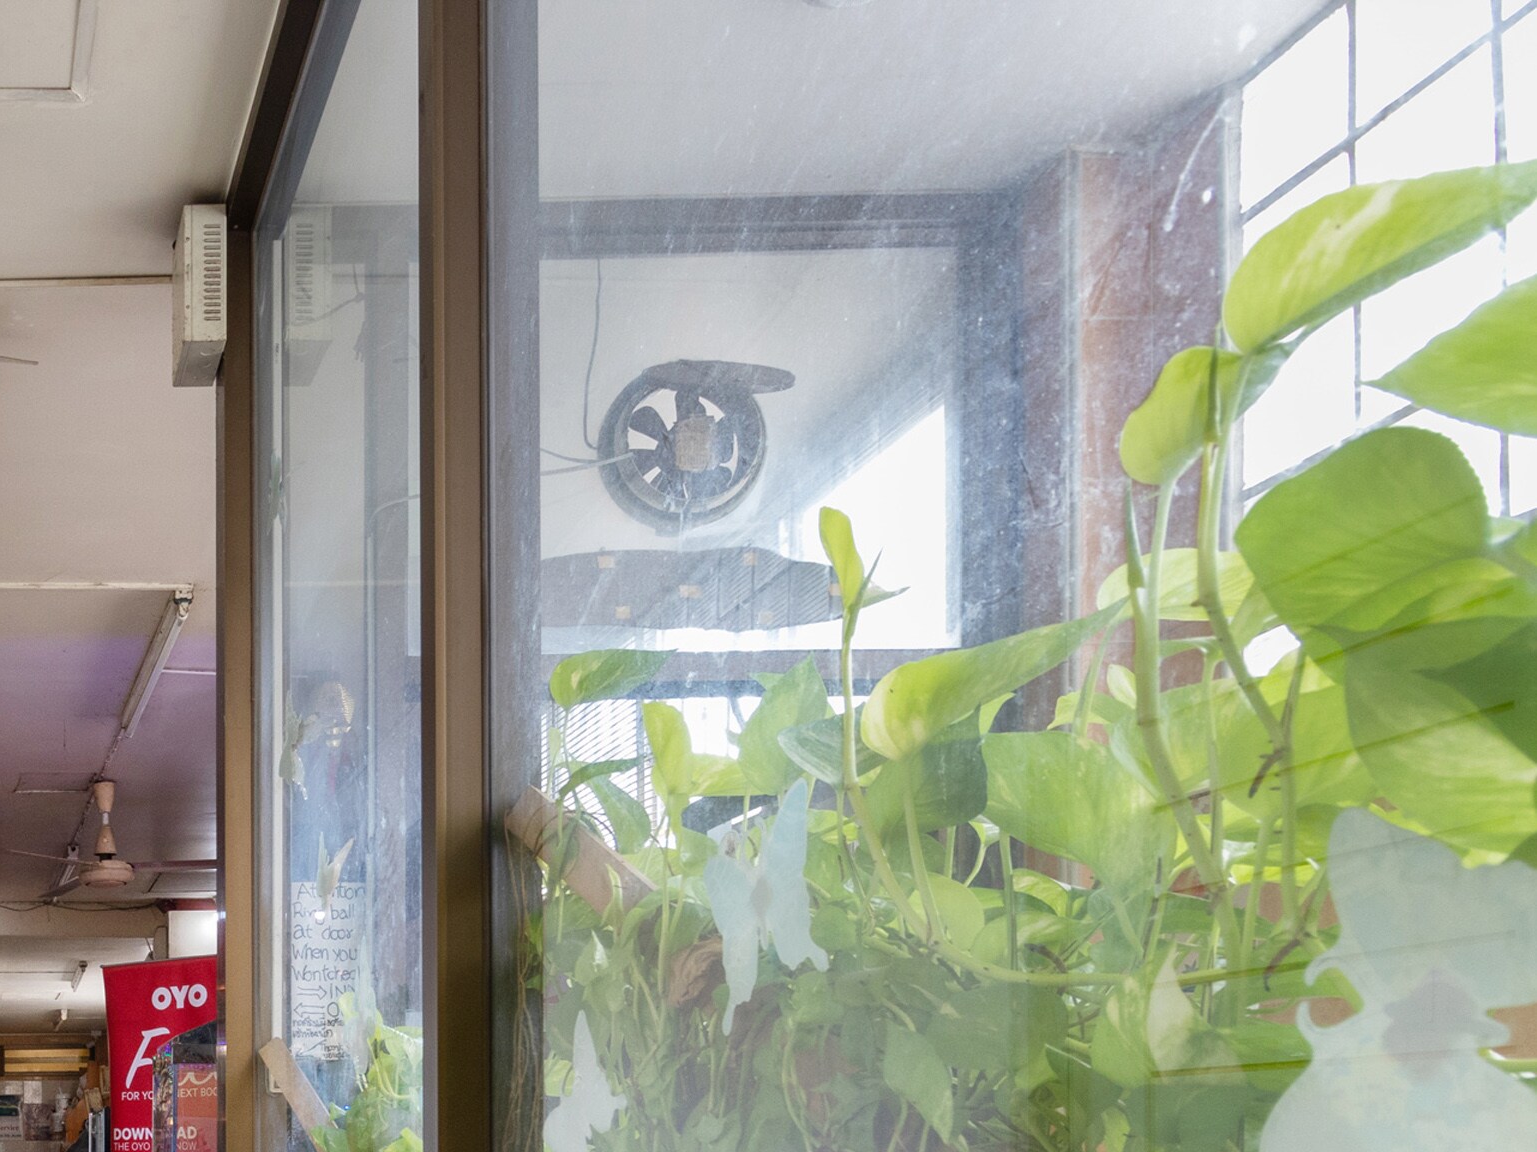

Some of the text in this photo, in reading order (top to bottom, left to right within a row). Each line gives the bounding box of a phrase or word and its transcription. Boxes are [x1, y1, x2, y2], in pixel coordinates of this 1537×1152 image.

[330, 903, 355, 920] ball
[292, 924, 354, 941] at door
[291, 943, 358, 961] When you
[151, 983, 208, 1010] OYO
[121, 1091, 140, 1101] FOR
[141, 1091, 154, 1101] YO
[113, 1126, 198, 1141] DOWNAD
[113, 1141, 130, 1151] THE
[131, 1141, 151, 1151] OYO
